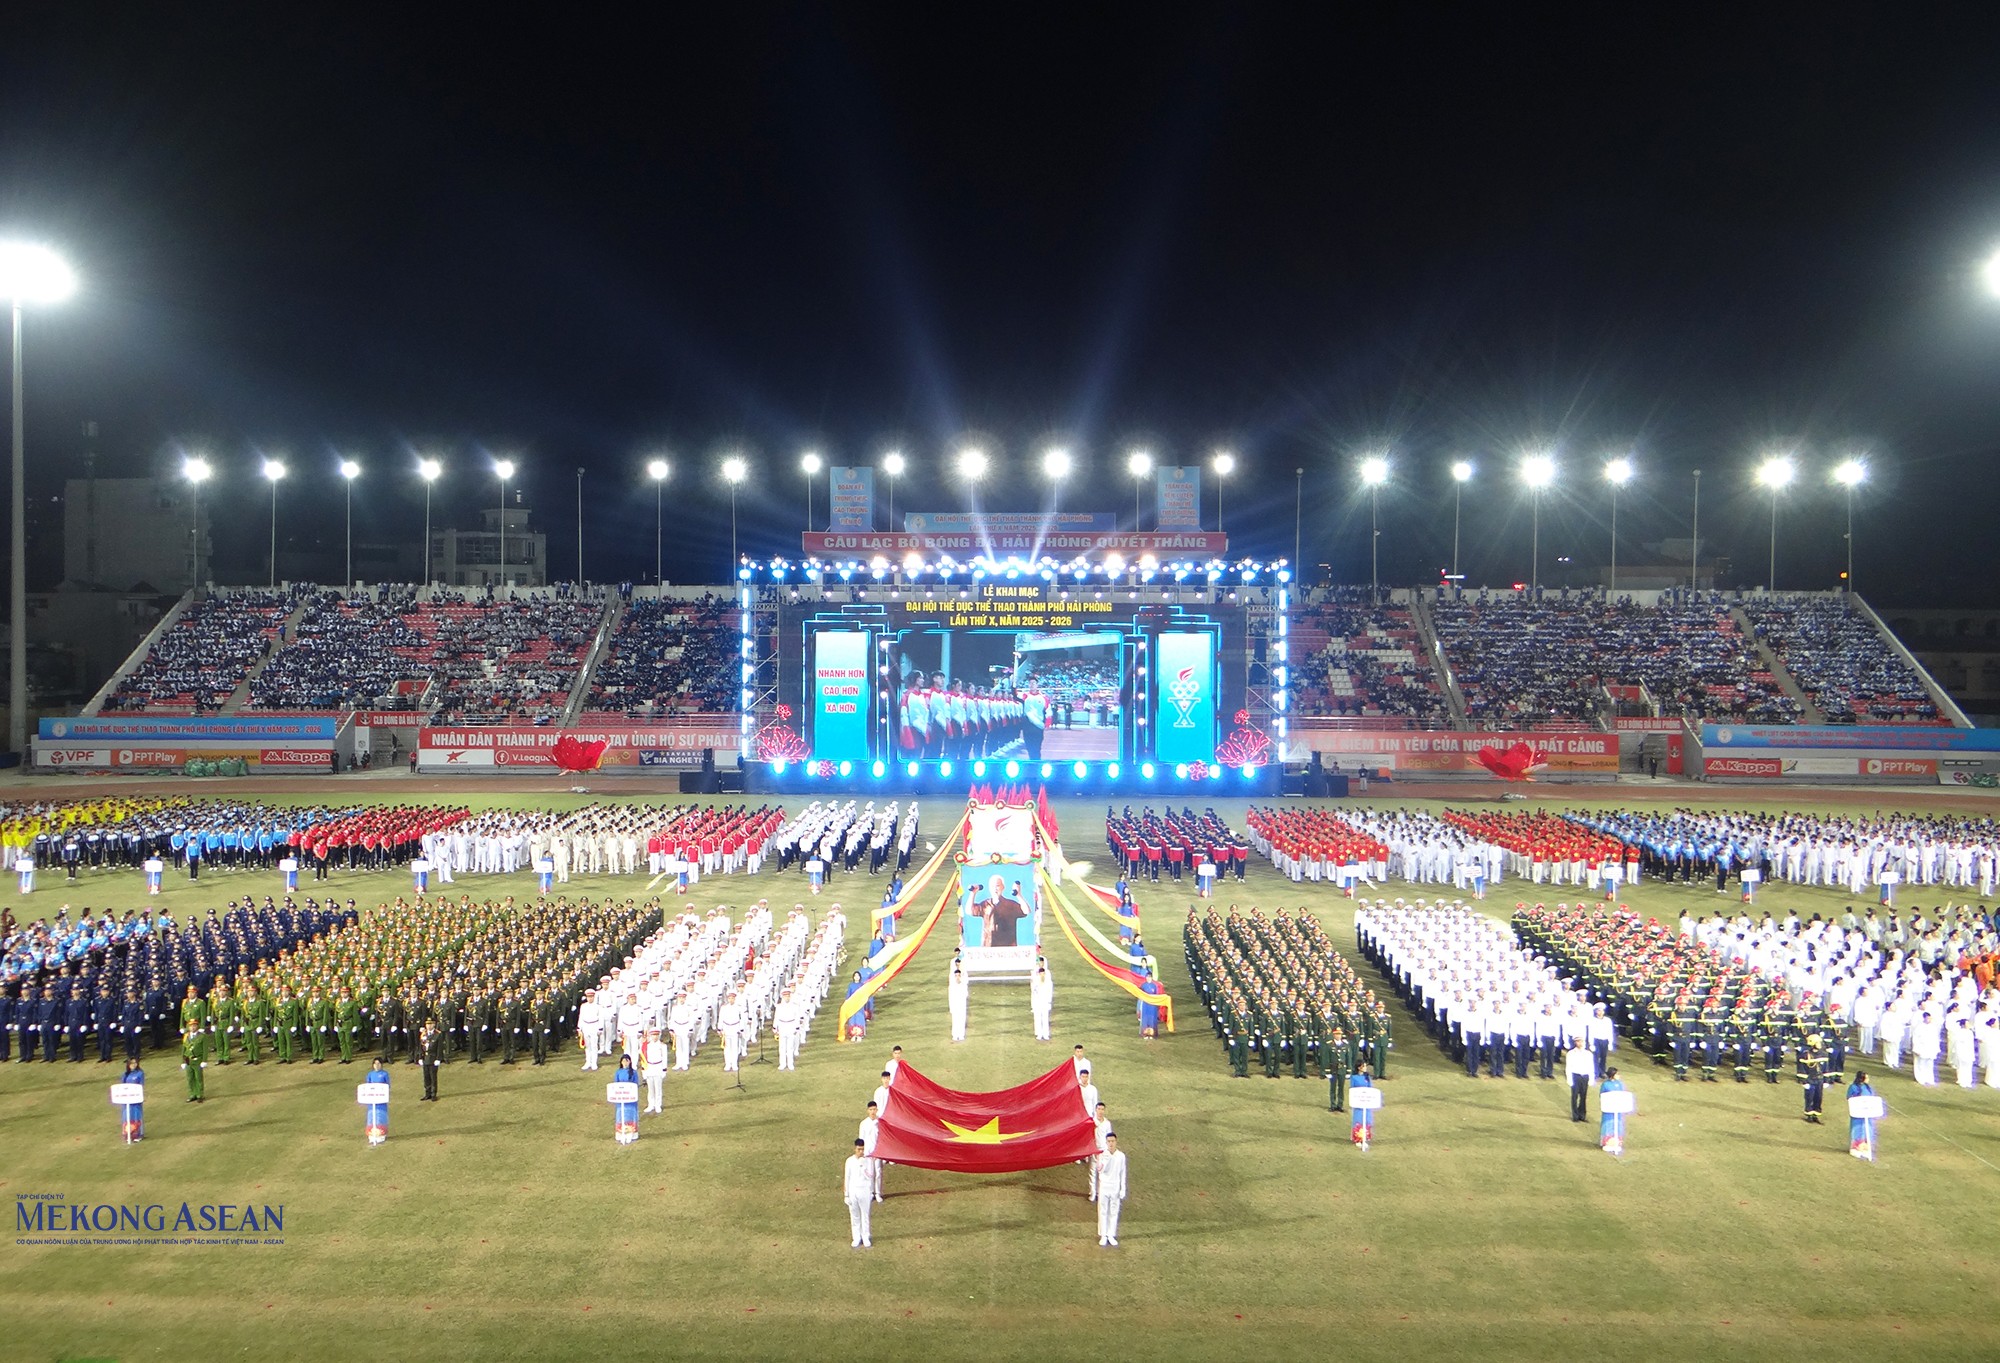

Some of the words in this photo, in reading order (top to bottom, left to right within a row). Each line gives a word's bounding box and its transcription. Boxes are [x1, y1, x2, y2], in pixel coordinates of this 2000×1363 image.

[823, 535, 857, 548] CÂU
[861, 537, 893, 550] LẠC
[897, 536, 920, 550] BỘ
[924, 535, 970, 548] BÓNG
[1002, 534, 1030, 548] HẢI
[1038, 535, 1092, 548] PHÒNG
[1098, 534, 1148, 549] QUYẾT
[1152, 534, 1207, 548] THẮNG
[995, 587, 1017, 597] KHAI
[1018, 587, 1039, 599] MẠC
[906, 601, 921, 613] ĐẠI
[922, 600, 937, 613] HỘI
[939, 598, 955, 612] THỂ
[956, 602, 974, 613] DỤC
[975, 598, 992, 612] THỂ
[993, 602, 1015, 612] THAO
[1017, 600, 1046, 612] THÀNH
[1047, 599, 1066, 612] PHỐ
[1066, 599, 1081, 612] HẢI
[1083, 600, 1113, 612] PHÒNG
[969, 614, 987, 626] THỨ
[988, 616, 998, 627] X,
[999, 614, 1021, 626] NĂM
[1021, 616, 1044, 626] 2025
[1050, 616, 1073, 626] 2026
[818, 669, 846, 678] NHANH
[848, 669, 865, 678] HƠN
[823, 686, 840, 695] CAO
[841, 686, 859, 695] HƠN
[826, 704, 837, 713] XA
[839, 703, 856, 713] HƠN
[432, 731, 466, 746] NHÂN
[468, 731, 493, 746] DÂN
[496, 731, 535, 746] THÀNH
[538, 730, 562, 746] PHỐ
[609, 734, 628, 746] TAY
[631, 730, 656, 747] ỦNG
[659, 731, 675, 749] HỘ
[678, 733, 695, 749] SỰ
[698, 732, 729, 747] PHÁT
[1378, 738, 1400, 751] TIN
[1404, 736, 1429, 751] YÊU
[1432, 735, 1459, 752] CỦA
[1538, 735, 1565, 753] ĐẤT
[1567, 736, 1605, 753] CẢNG
[65, 751, 95, 761] VPF
[134, 752, 154, 762] FPT
[155, 752, 177, 764] Play
[281, 751, 331, 763] Kappa
[1402, 757, 1440, 769] LPBank
[1726, 760, 1777, 773] Kappa
[1883, 762, 1904, 772] FPT
[1905, 762, 1928, 774] Play
